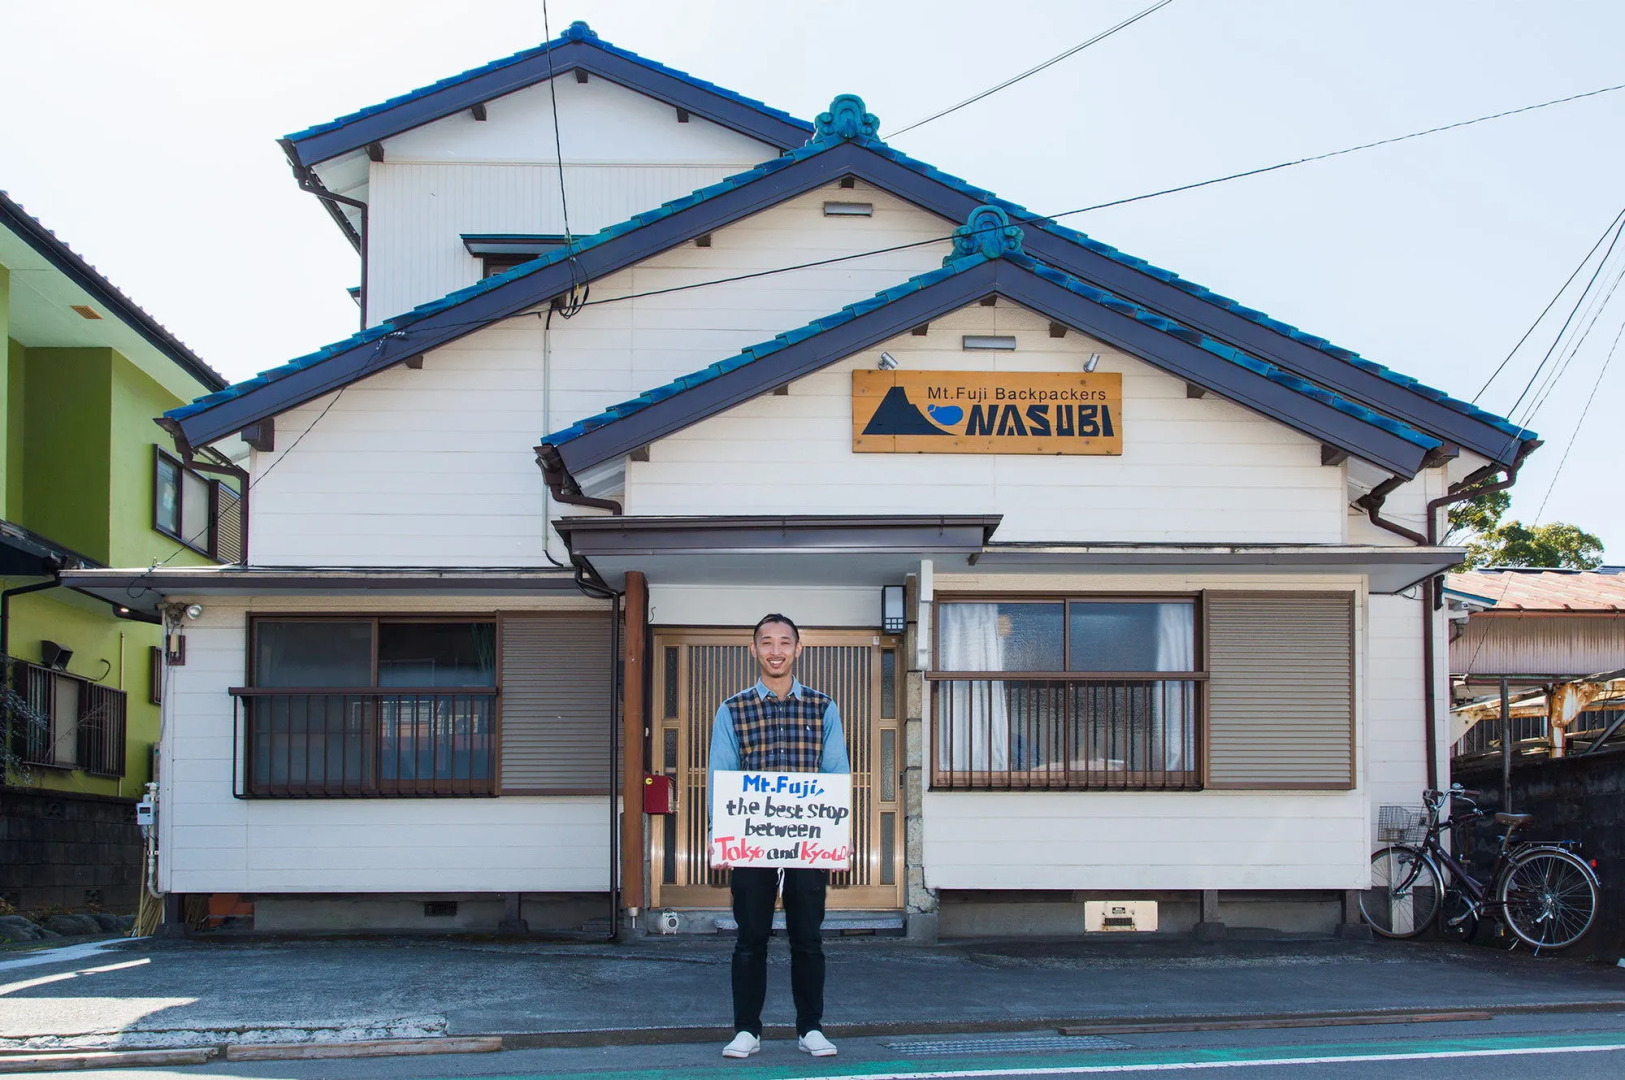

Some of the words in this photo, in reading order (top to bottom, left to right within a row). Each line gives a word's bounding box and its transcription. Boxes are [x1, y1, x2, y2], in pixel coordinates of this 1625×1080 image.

[927, 386, 988, 402] Mt.Fuji
[995, 387, 1107, 402] Backpackers
[965, 404, 1115, 437] NASUBI
[726, 797, 760, 816] the
[764, 796, 804, 819] best
[744, 818, 822, 839] between
[714, 836, 765, 863] Tokyo
[766, 842, 800, 860] and
